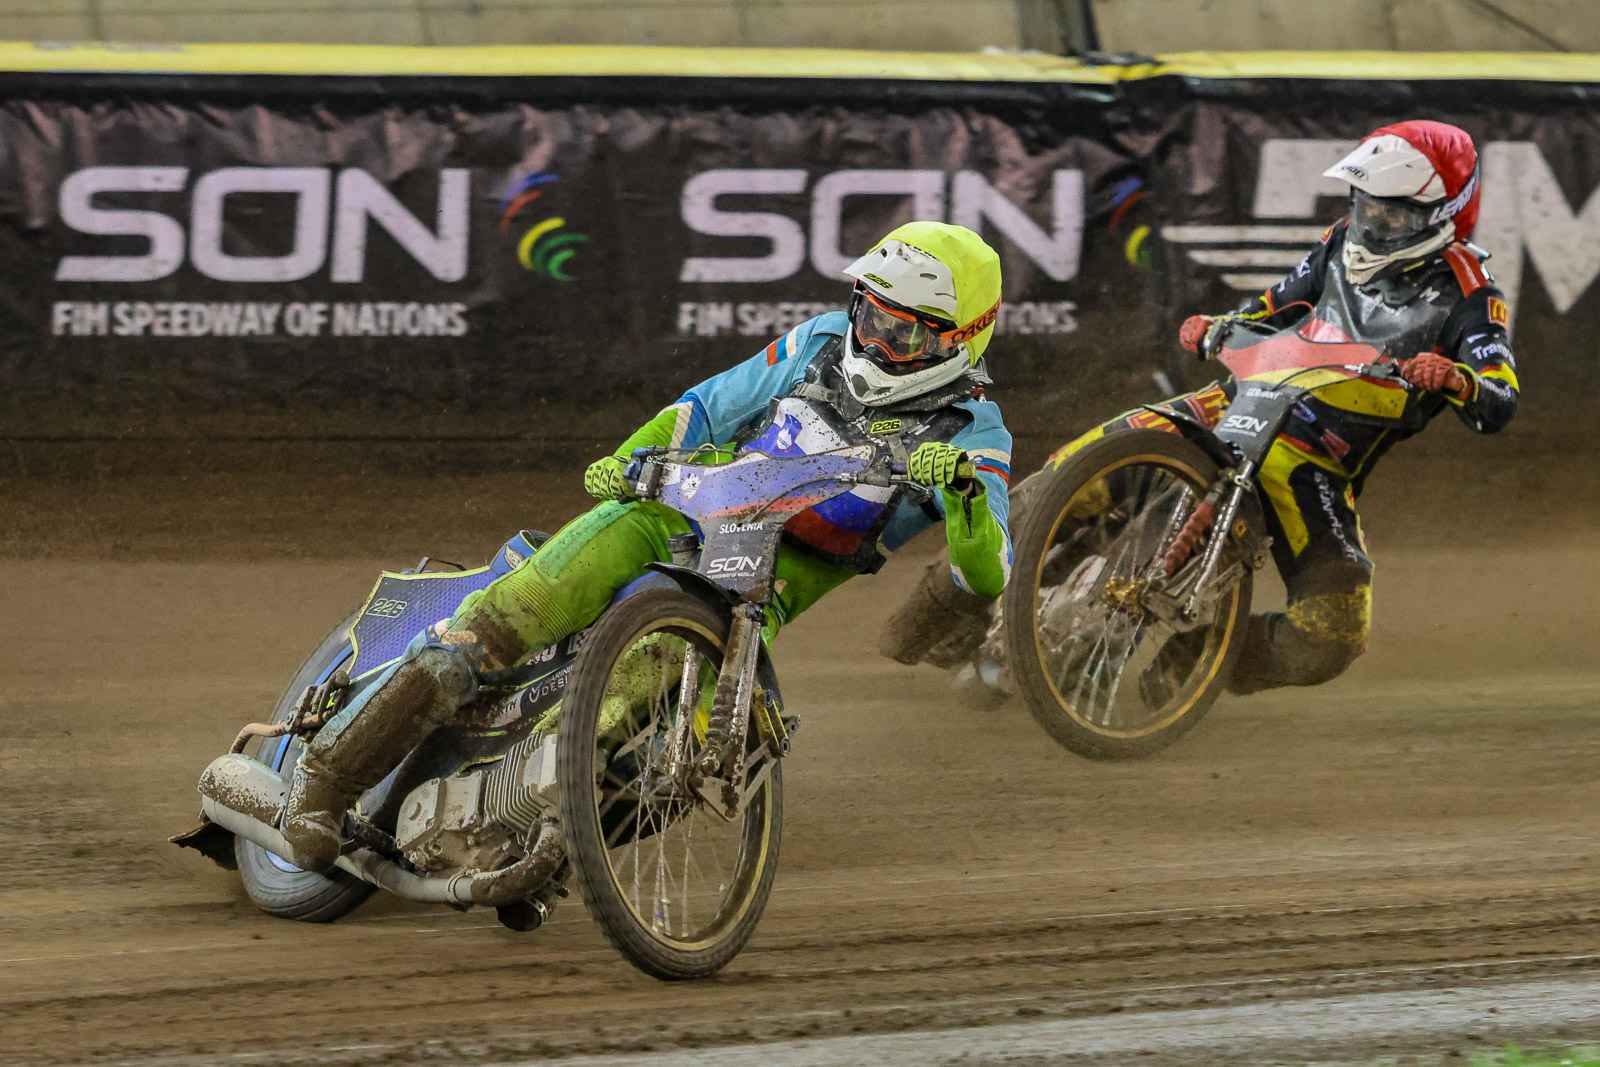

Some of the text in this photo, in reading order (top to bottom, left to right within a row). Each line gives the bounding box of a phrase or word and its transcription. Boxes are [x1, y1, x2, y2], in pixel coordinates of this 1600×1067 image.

[54, 166, 472, 283] SON
[680, 169, 1084, 283] SON
[53, 302, 468, 337] FIM SPEEDWAY OF NATIONS
[677, 302, 734, 338] FIM
[870, 419, 901, 434] 226
[1223, 414, 1269, 433] SON
[706, 555, 763, 574] SON
[366, 597, 408, 619] 226
